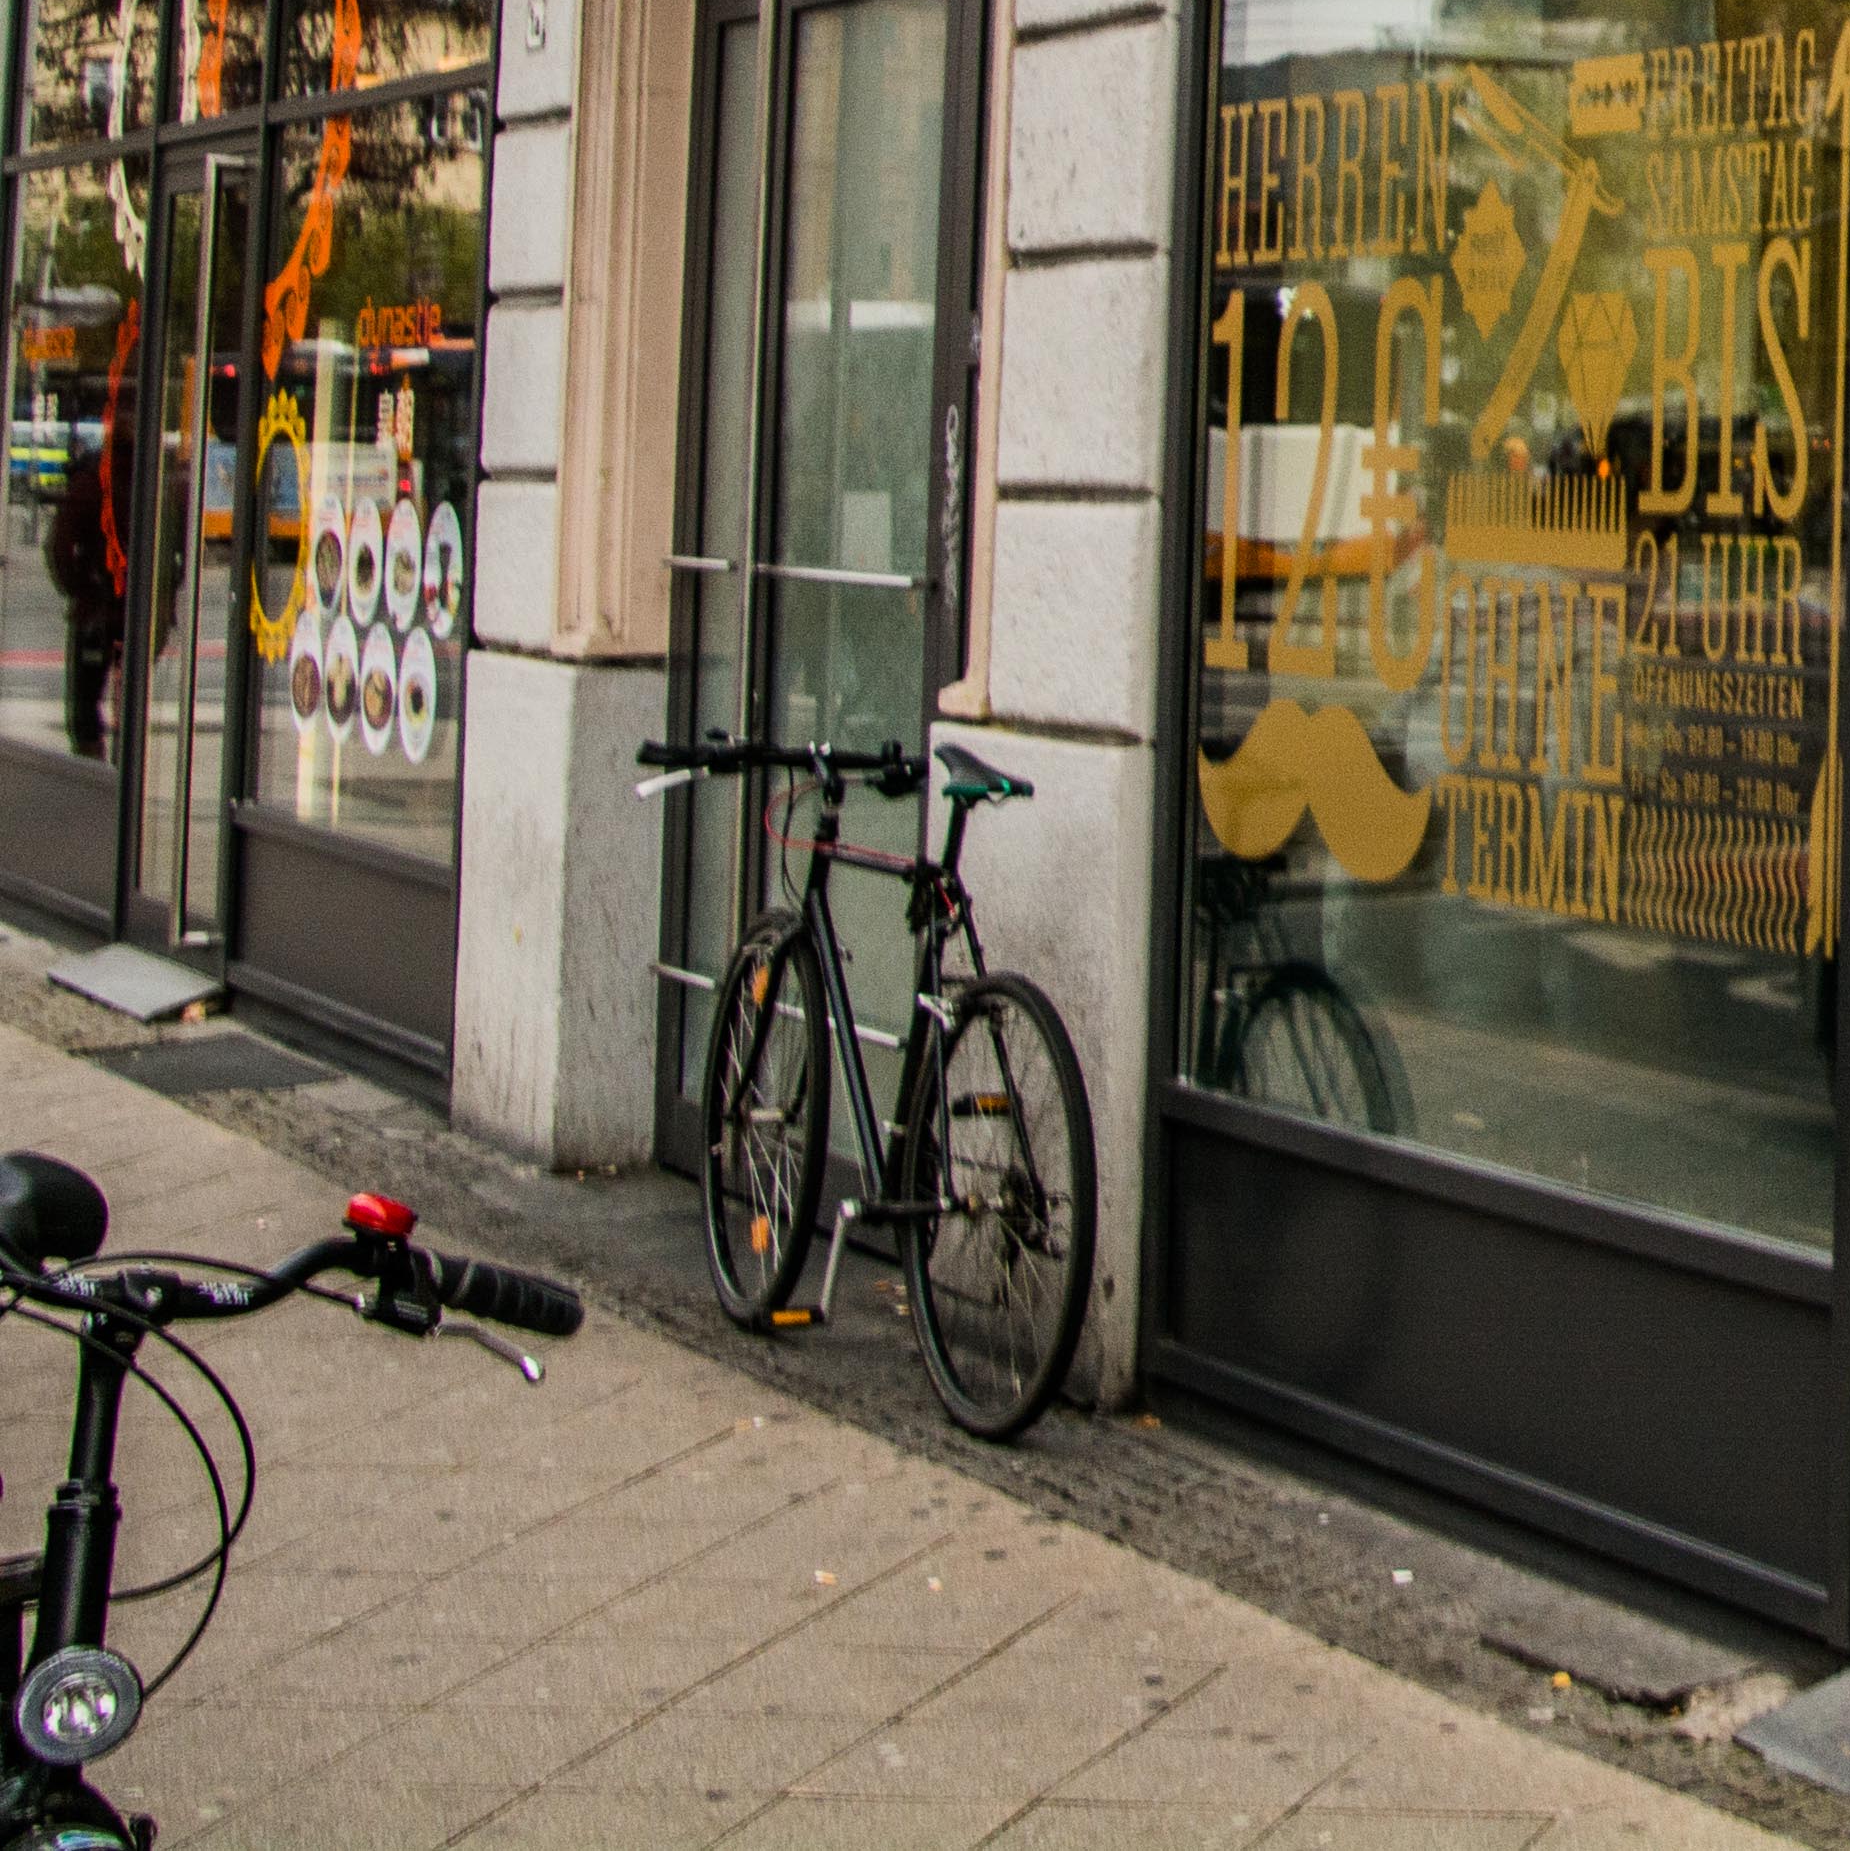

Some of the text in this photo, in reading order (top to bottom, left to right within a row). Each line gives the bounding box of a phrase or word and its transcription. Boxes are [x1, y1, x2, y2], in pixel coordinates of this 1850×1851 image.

[1645, 29, 1817, 138] FREITAG
[1214, 77, 1454, 270] HERREN
[1644, 138, 1813, 238] SAMSTAG
[1638, 240, 1811, 523] BIS
[1205, 275, 1444, 693] 12€
[1440, 574, 1627, 784] OHNE
[1632, 532, 1803, 668] 21 UHR
[1436, 773, 1625, 924] TERMIN
